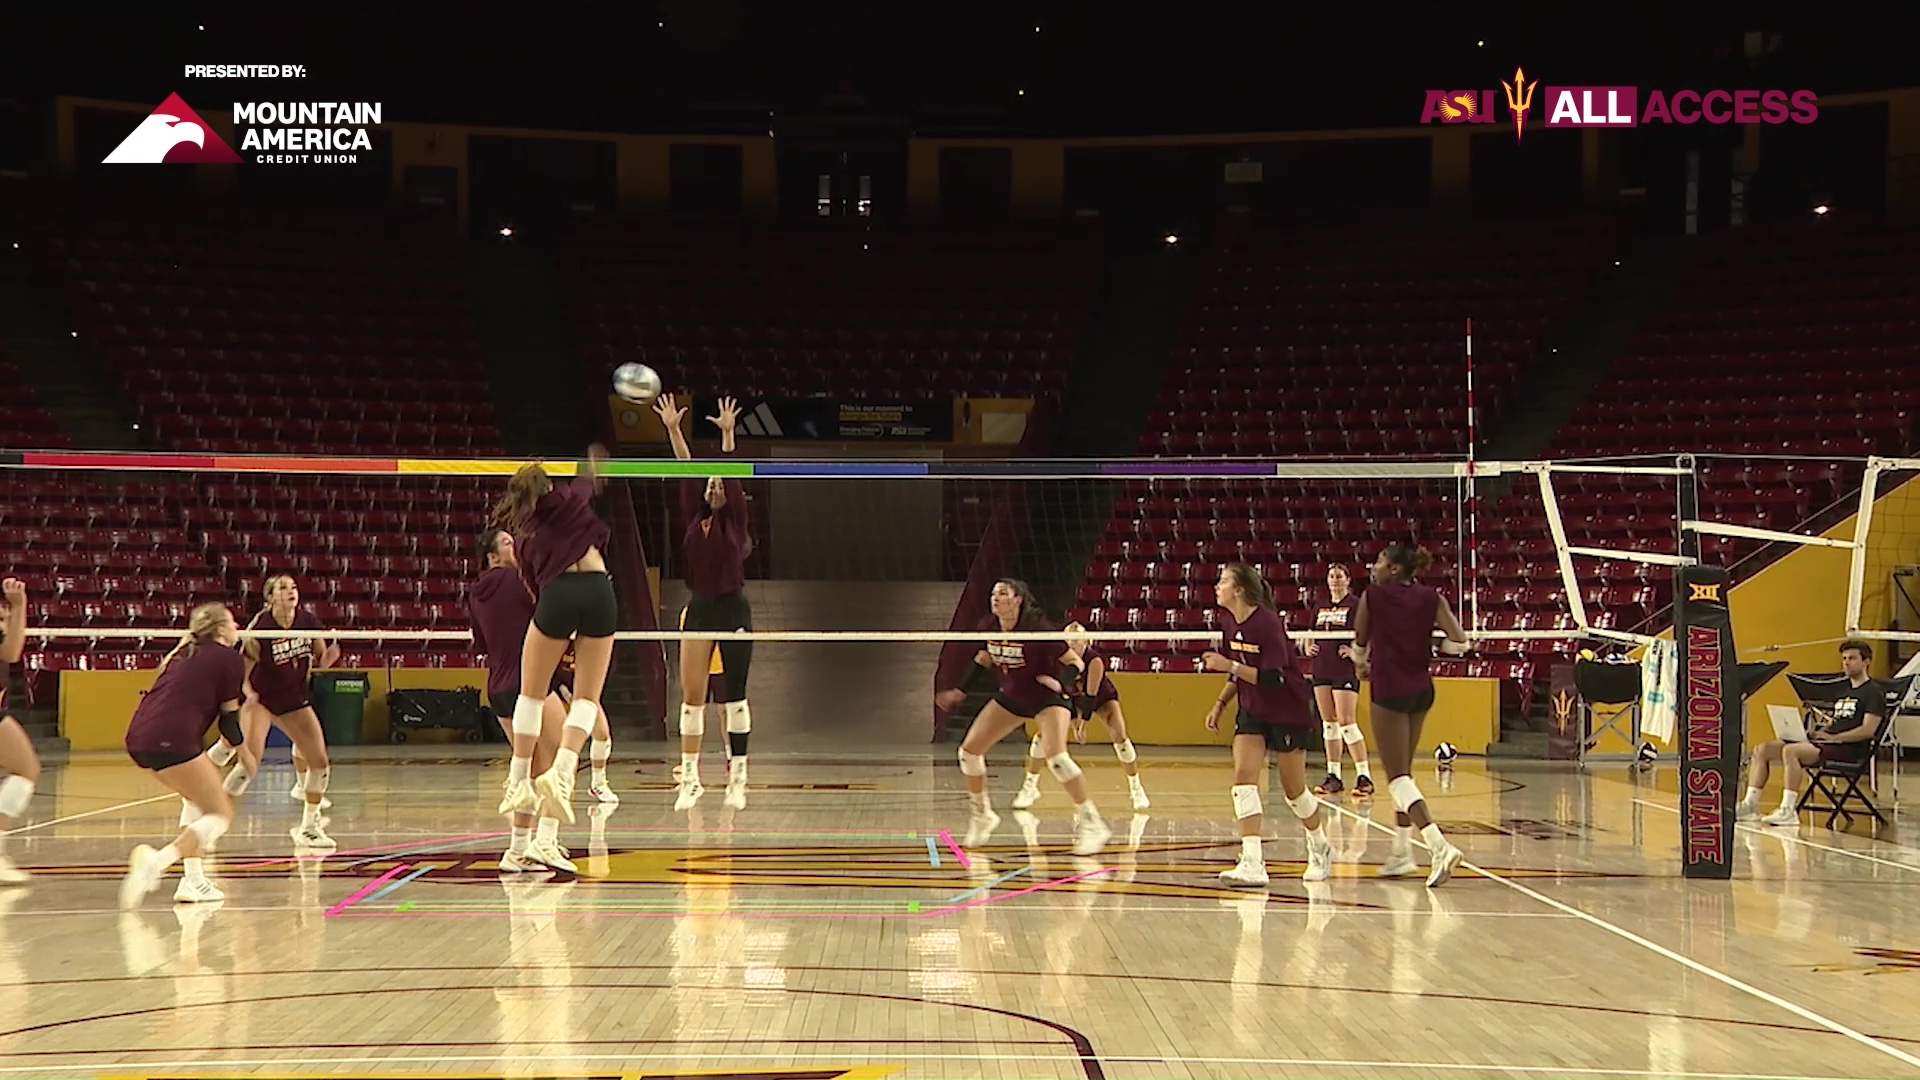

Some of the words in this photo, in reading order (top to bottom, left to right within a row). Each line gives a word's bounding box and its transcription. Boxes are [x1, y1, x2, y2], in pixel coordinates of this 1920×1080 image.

[839, 404, 855, 412] This
[1686, 625, 1723, 761] ARIZONA
[1687, 768, 1723, 865] STATE
